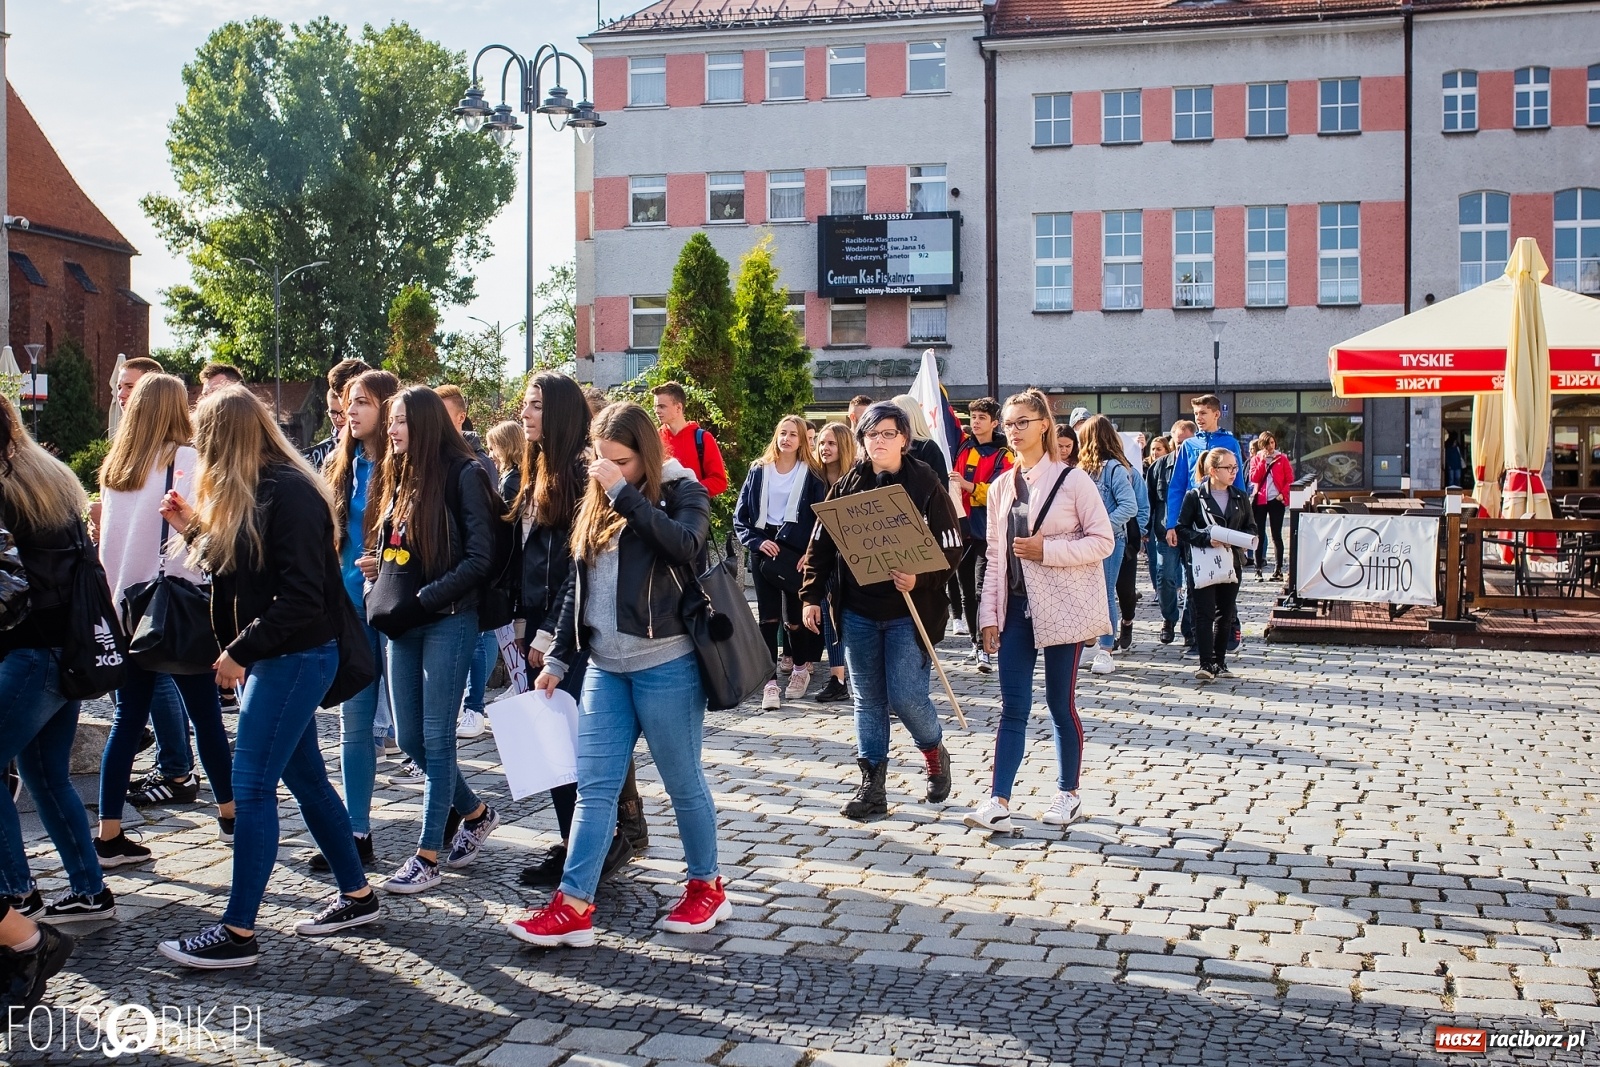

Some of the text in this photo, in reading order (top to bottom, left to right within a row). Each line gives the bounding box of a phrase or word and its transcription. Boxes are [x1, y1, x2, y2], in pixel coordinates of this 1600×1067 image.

[827, 269, 915, 284] Centrum Kas Fiskalnych
[1399, 353, 1454, 367] TYSKIE
[845, 499, 884, 519] NASZE
[862, 534, 901, 550] OCALI
[1529, 560, 1570, 573] TYSKIE
